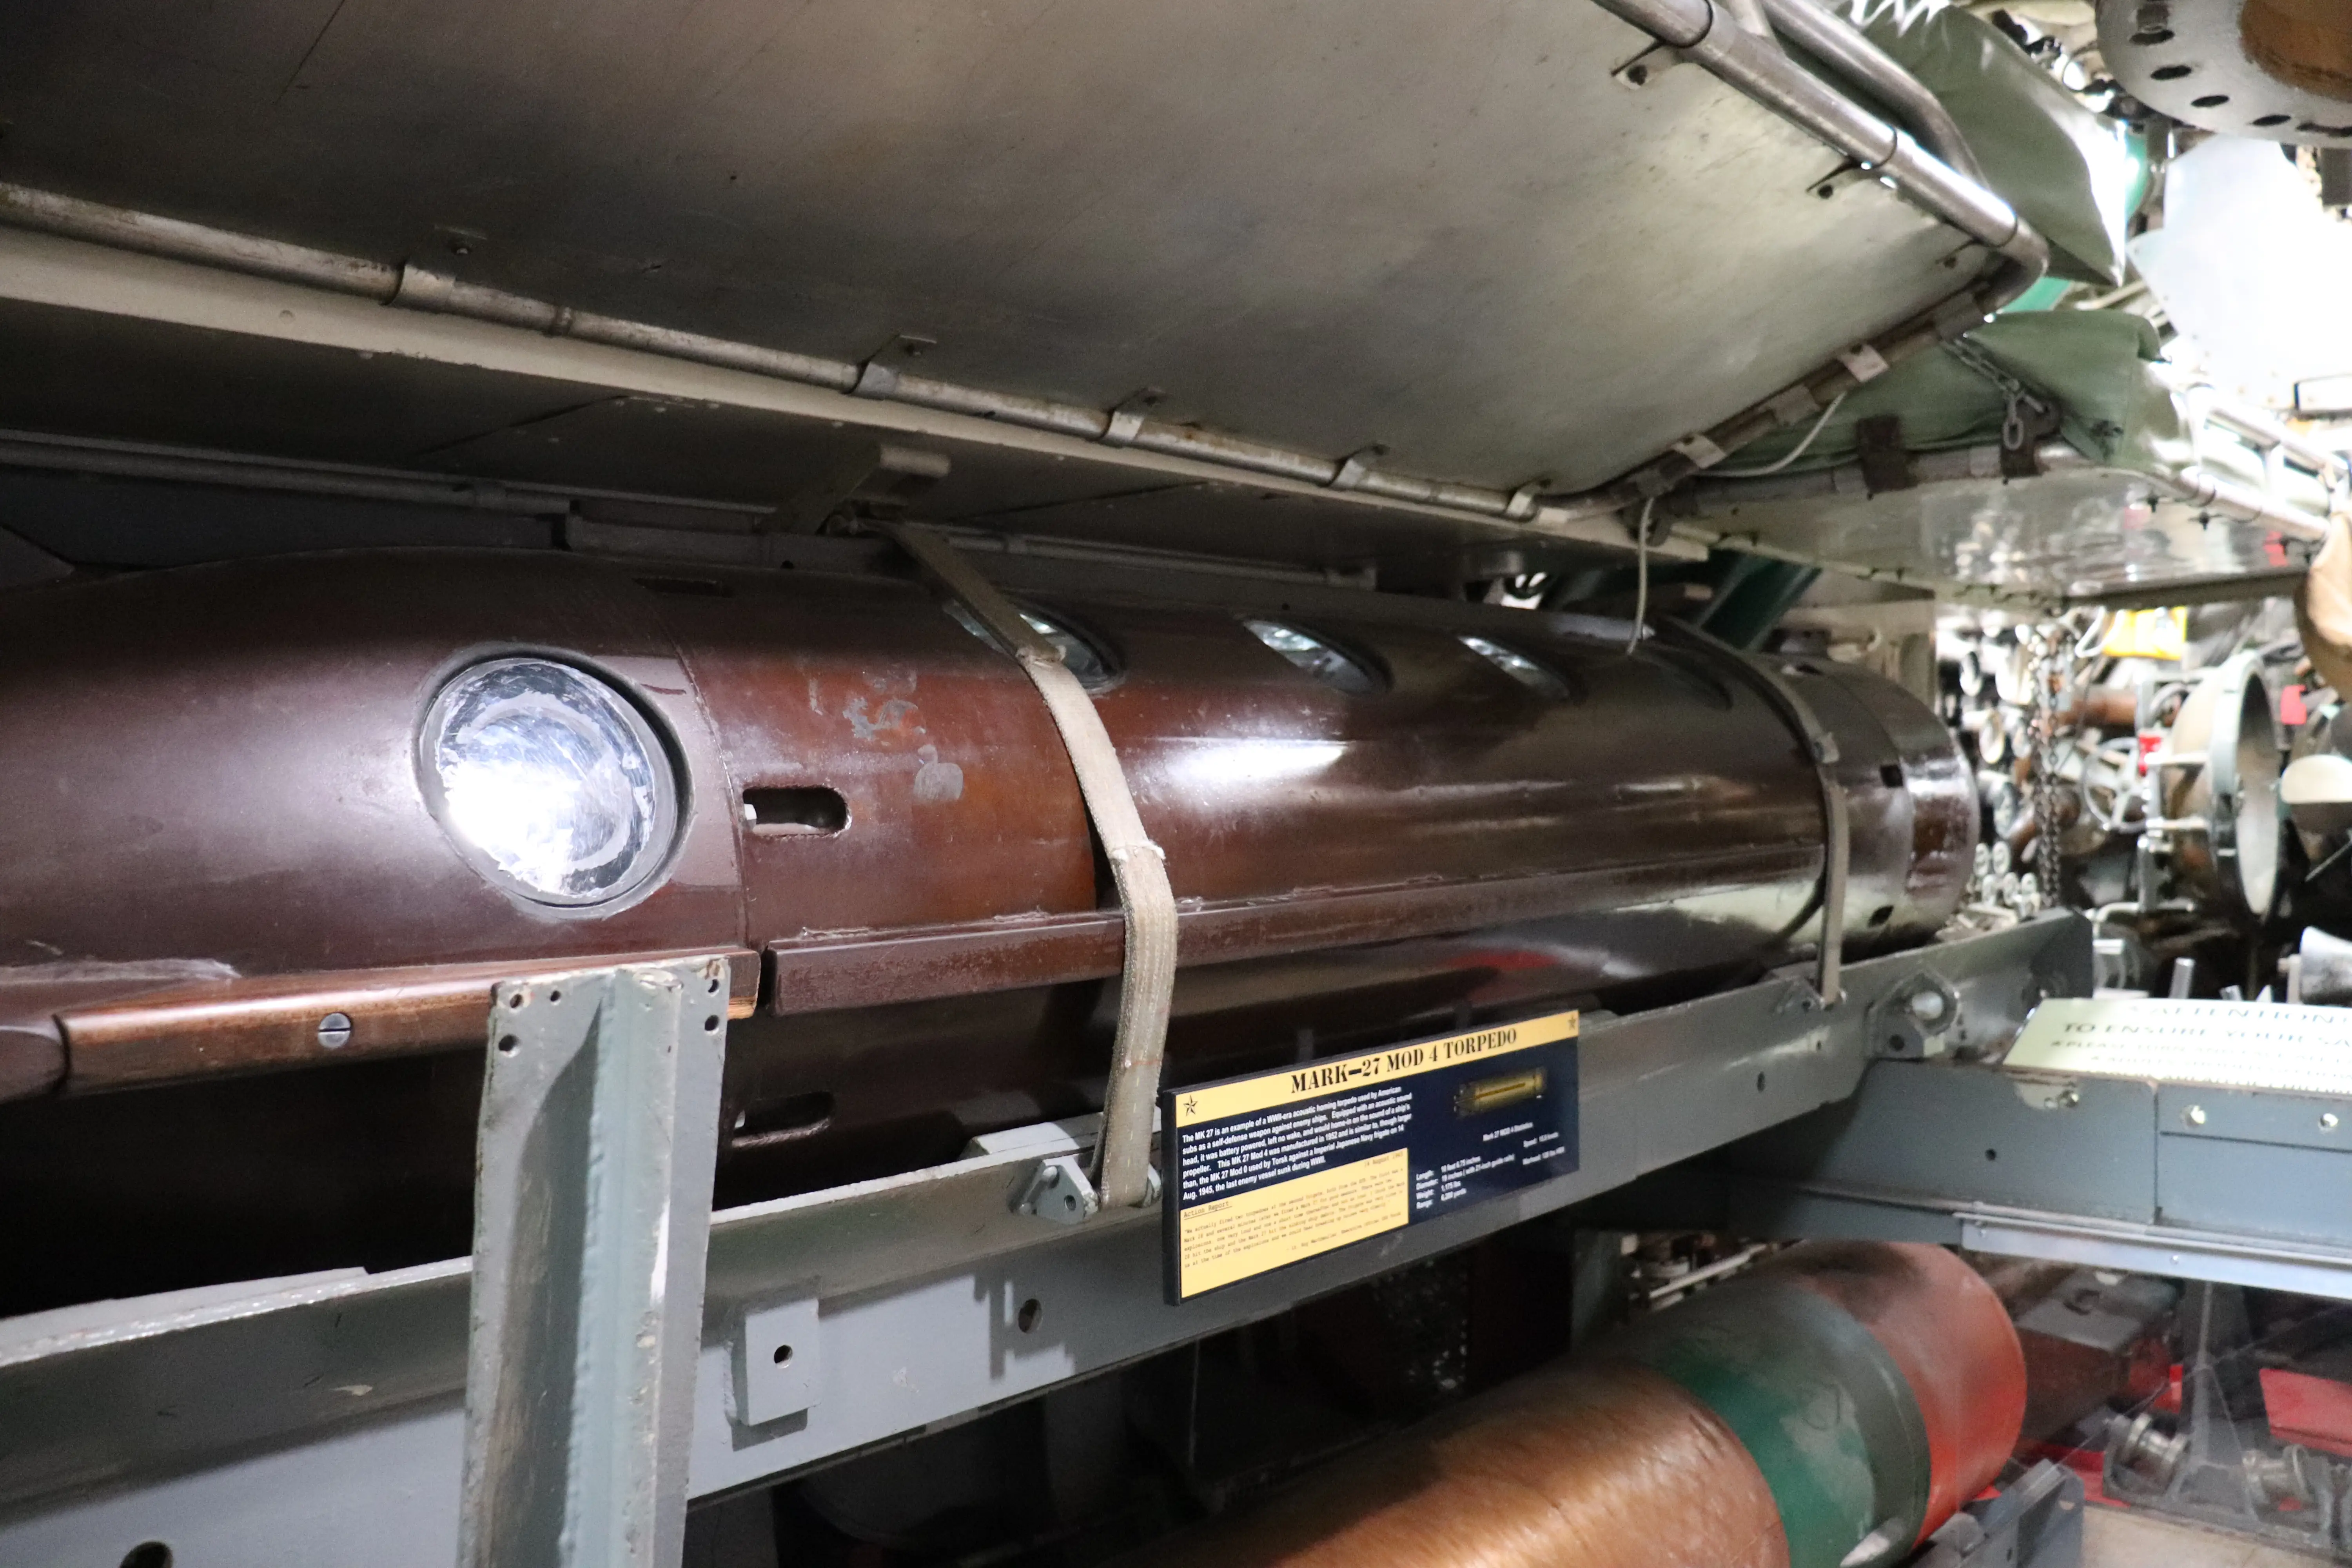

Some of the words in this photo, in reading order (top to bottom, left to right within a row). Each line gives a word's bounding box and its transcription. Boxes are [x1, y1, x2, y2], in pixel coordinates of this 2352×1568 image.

[2064, 1022, 2095, 1034] TO
[1387, 1049, 1423, 1071] MOD
[1430, 1045, 1437, 1061] 4
[1444, 1029, 1516, 1058] TORPEDO
[1182, 1134, 1194, 1143] The
[1195, 1130, 1205, 1140] MK
[1206, 1129, 1213, 1138] 27
[1230, 1120, 1254, 1132] example
[1255, 1117, 1261, 1126] of
[1292, 1105, 1316, 1117] acoustic
[1316, 1102, 1336, 1111] homing
[1357, 1092, 1370, 1102] used
[1370, 1091, 1377, 1100] by
[1182, 1145, 1197, 1154] subs
[1212, 1133, 1247, 1147] self-defense
[1249, 1128, 1271, 1138] weapon
[1271, 1122, 1292, 1134] against
[1292, 1118, 1311, 1128] enemy
[1183, 1155, 1199, 1166] head,
[1205, 1152, 1218, 1160] was
[1219, 1146, 1240, 1157] battery
[1240, 1138, 1267, 1153] powered,
[1267, 1136, 1277, 1145] left
[1303, 1127, 1313, 1136] and
[1314, 1122, 1330, 1133] would
[1183, 1165, 1211, 1179] propeller.
[1217, 1159, 1230, 1168] This
[1231, 1155, 1241, 1165] MK
[1242, 1153, 1249, 1162] 27
[1250, 1150, 1263, 1160] Mod
[1269, 1147, 1280, 1155] was
[1281, 1136, 1318, 1152] manufactured
[1325, 1131, 1338, 1140] 1952
[1338, 1128, 1348, 1138] and
[1183, 1180, 1198, 1189] than,
[1199, 1176, 1209, 1185] the
[1210, 1172, 1220, 1181] MK
[1221, 1169, 1228, 1179] 27
[1229, 1166, 1243, 1176] Mod
[1248, 1161, 1263, 1172] used
[1263, 1160, 1270, 1169] by
[1272, 1155, 1288, 1165] Torsk
[1288, 1149, 1308, 1162] against
[1314, 1142, 1335, 1154] Imperial
[1183, 1191, 1197, 1200] Aug.
[1199, 1185, 1214, 1196] 1945,
[1215, 1183, 1225, 1191] the
[1226, 1179, 1237, 1189] last
[1238, 1175, 1257, 1185] enemy
[1258, 1168, 1276, 1180] vessel
[1277, 1165, 1291, 1175] sunk
[1292, 1161, 1310, 1171] during
[1183, 1208, 1205, 1218] Action
[1208, 1201, 1229, 1213] Report
